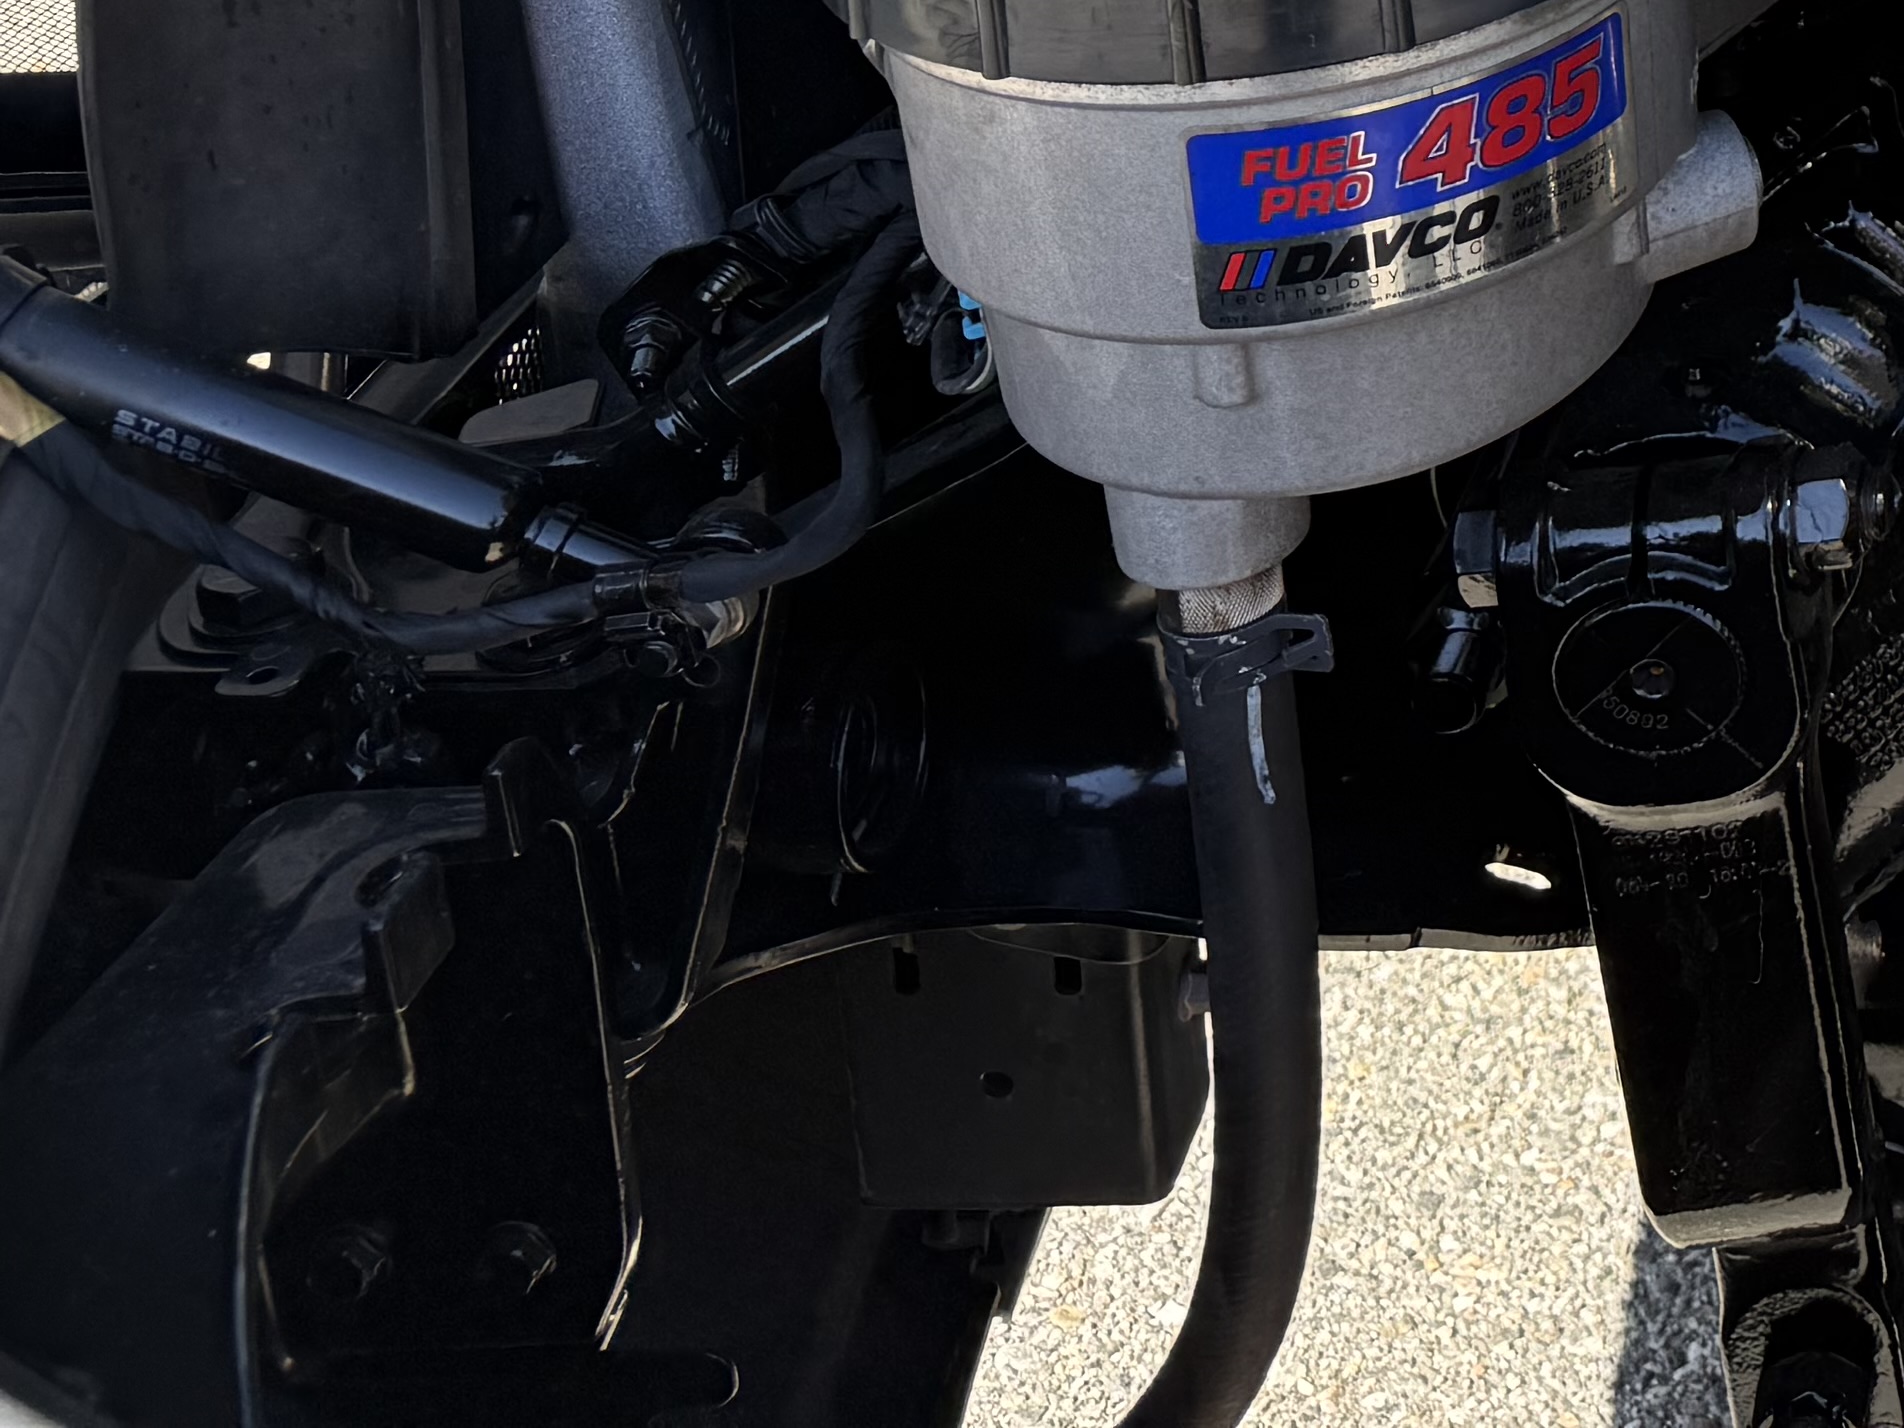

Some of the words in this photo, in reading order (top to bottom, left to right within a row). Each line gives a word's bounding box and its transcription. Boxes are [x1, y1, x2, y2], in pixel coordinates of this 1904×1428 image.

[1240, 129, 1378, 188] FUEL
[1394, 31, 1604, 194] 485
[1258, 170, 1374, 226] PRO
[1510, 142, 1607, 201] www.davco.com
[1433, 240, 1483, 268] LLC
